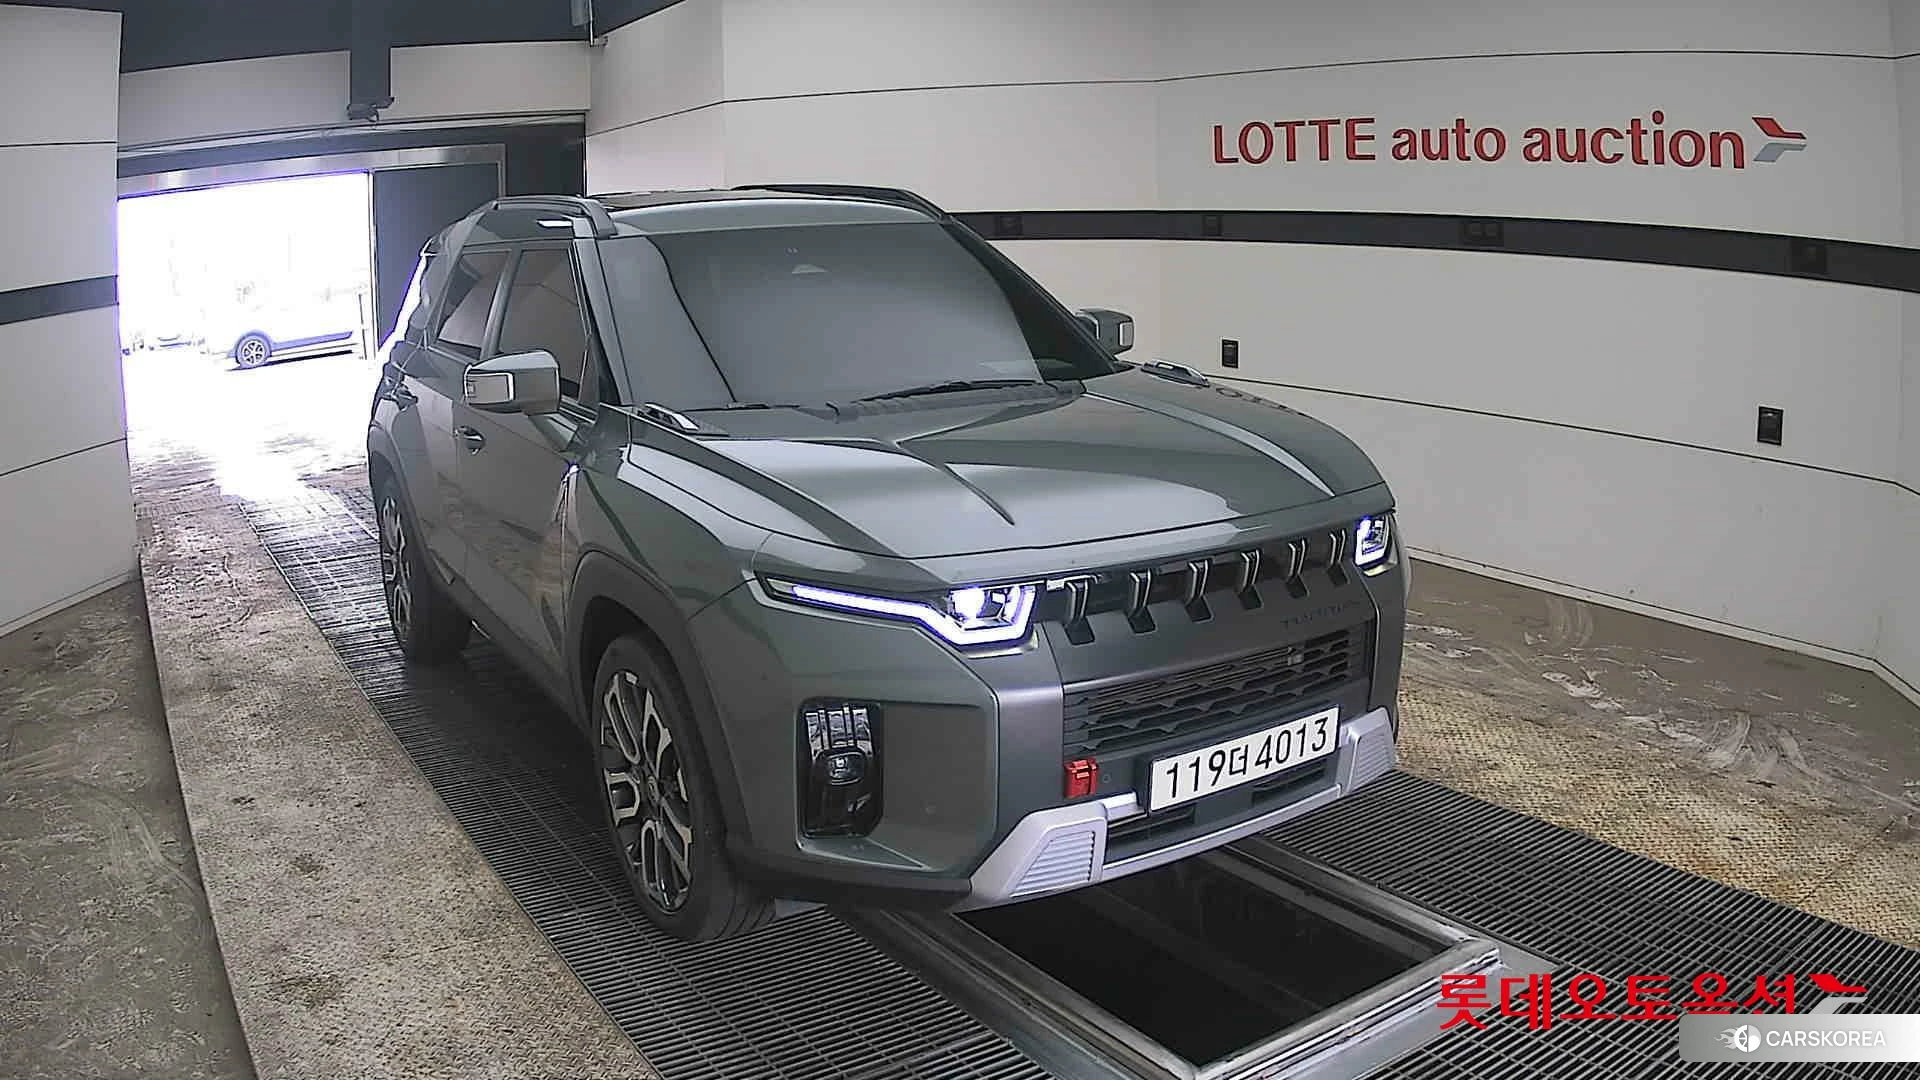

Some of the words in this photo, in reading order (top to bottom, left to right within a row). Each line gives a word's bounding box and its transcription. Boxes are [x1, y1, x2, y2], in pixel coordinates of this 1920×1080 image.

[1212, 117, 1376, 164] LOTTE
[1391, 117, 1507, 162] auto
[1522, 109, 1746, 169] auction
[1165, 743, 1249, 799] 119더
[1254, 716, 1329, 770] 4013
